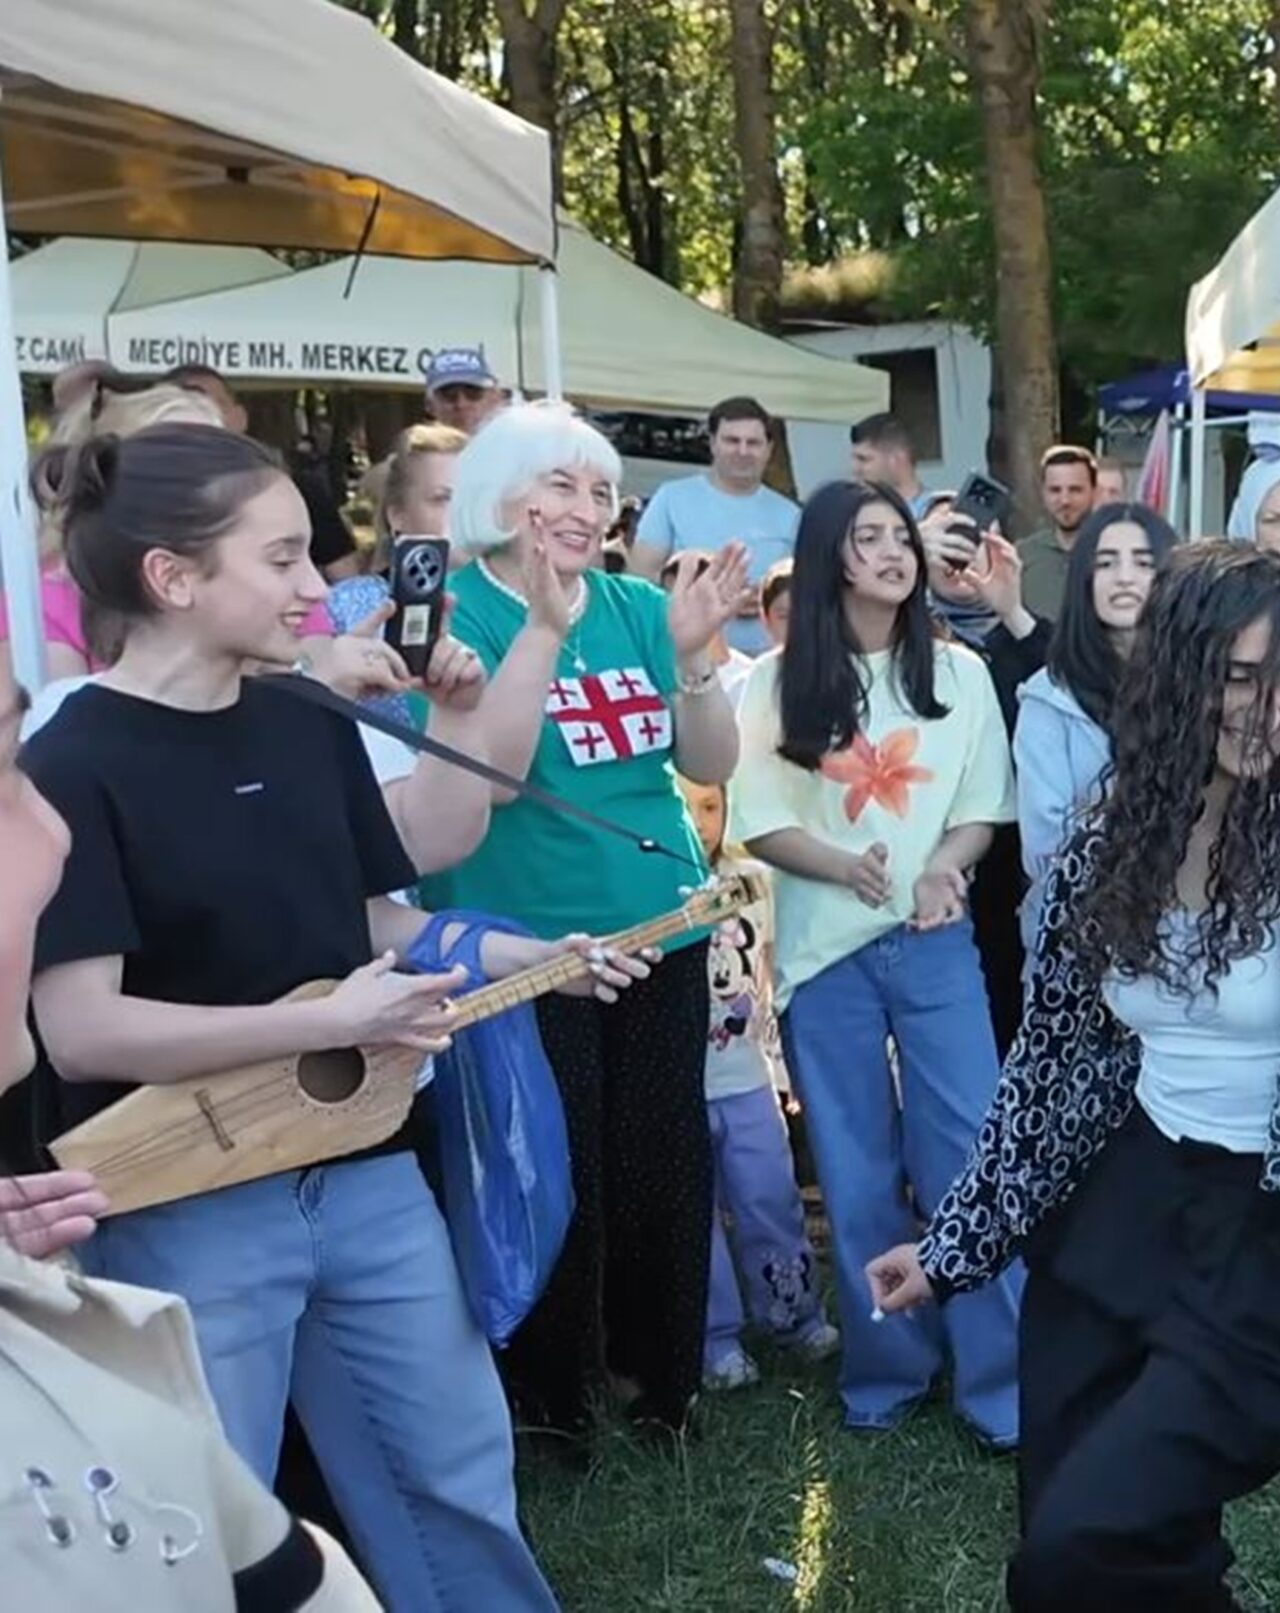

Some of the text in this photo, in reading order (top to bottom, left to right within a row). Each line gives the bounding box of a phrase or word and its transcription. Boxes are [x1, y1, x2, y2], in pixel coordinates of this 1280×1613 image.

[129, 336, 241, 367] MECİDİYE
[248, 342, 293, 369] MH.
[302, 344, 410, 374] MERKEZ
